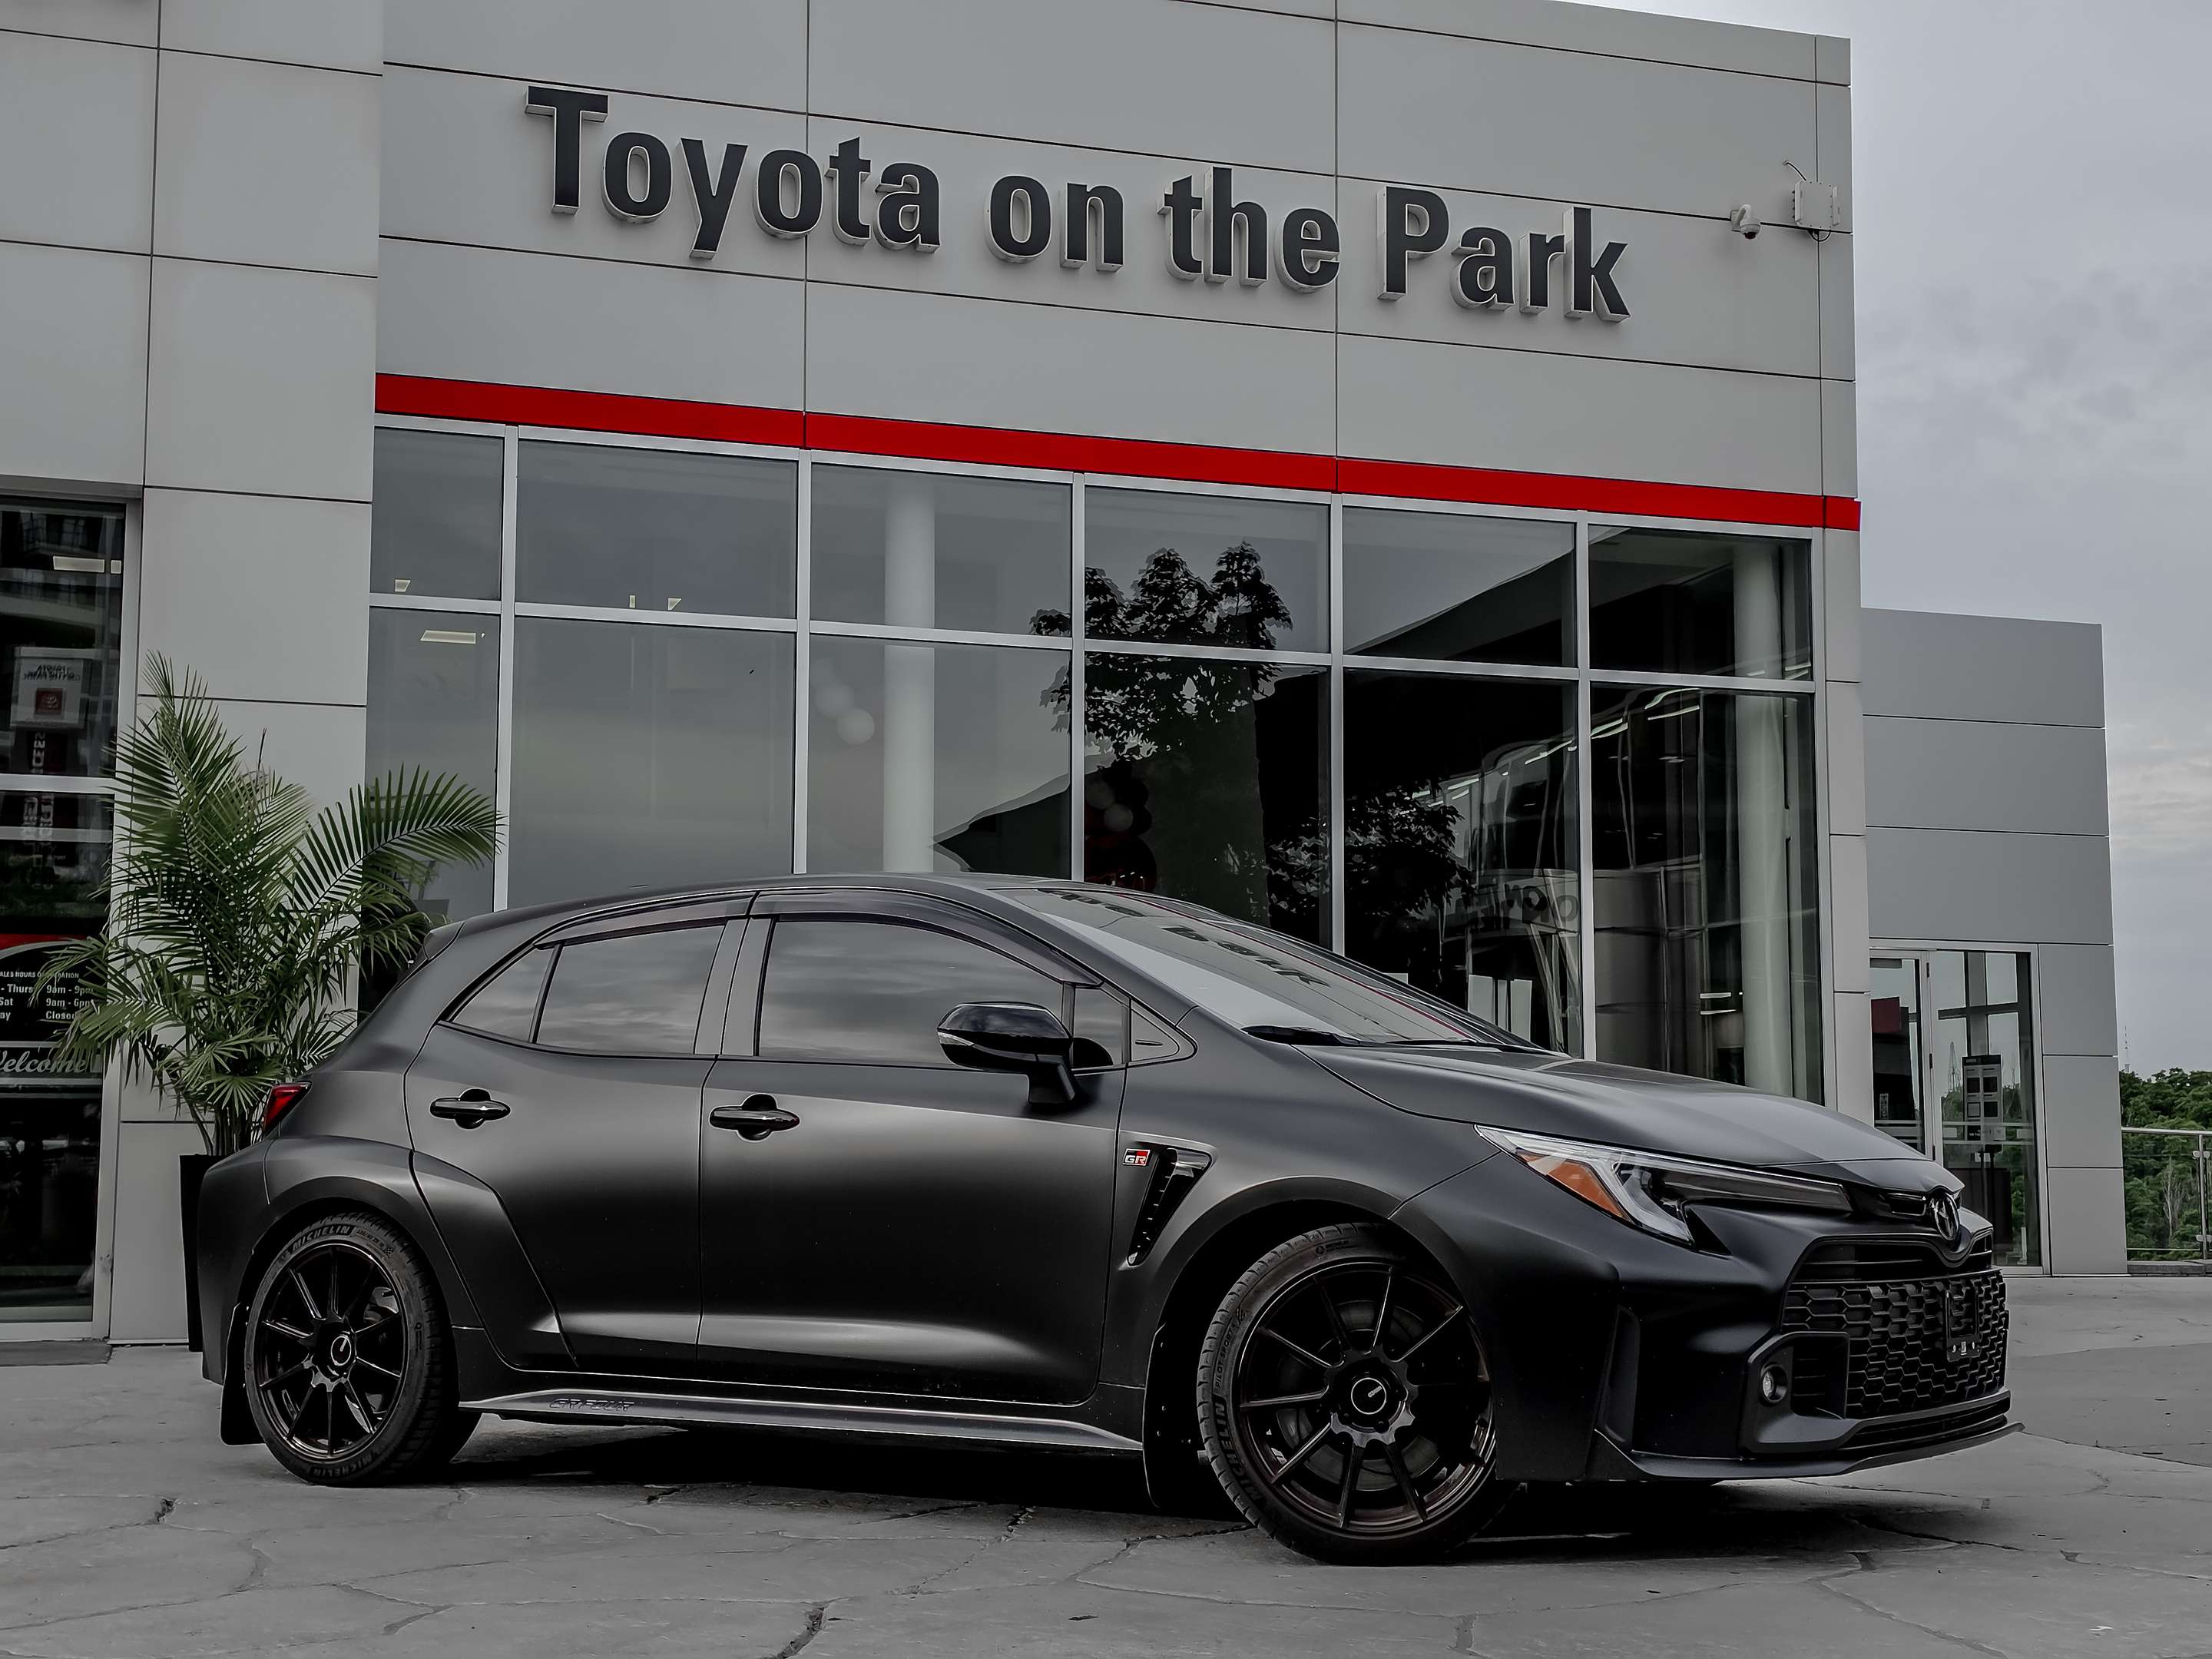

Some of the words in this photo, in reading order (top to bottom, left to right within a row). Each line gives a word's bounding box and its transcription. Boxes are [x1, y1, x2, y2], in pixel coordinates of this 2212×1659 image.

[525, 85, 940, 259] Toyota
[985, 175, 1124, 272] on
[1157, 166, 1340, 293] the
[1377, 186, 1631, 323] Park
[7, 984, 34, 994] Thurs
[46, 984, 66, 995] 9am
[46, 998, 65, 1007] 9am
[1124, 1154, 1147, 1164] GR
[292, 1224, 351, 1251] MICHELIN
[1214, 1401, 1264, 1501] MICHELIN
